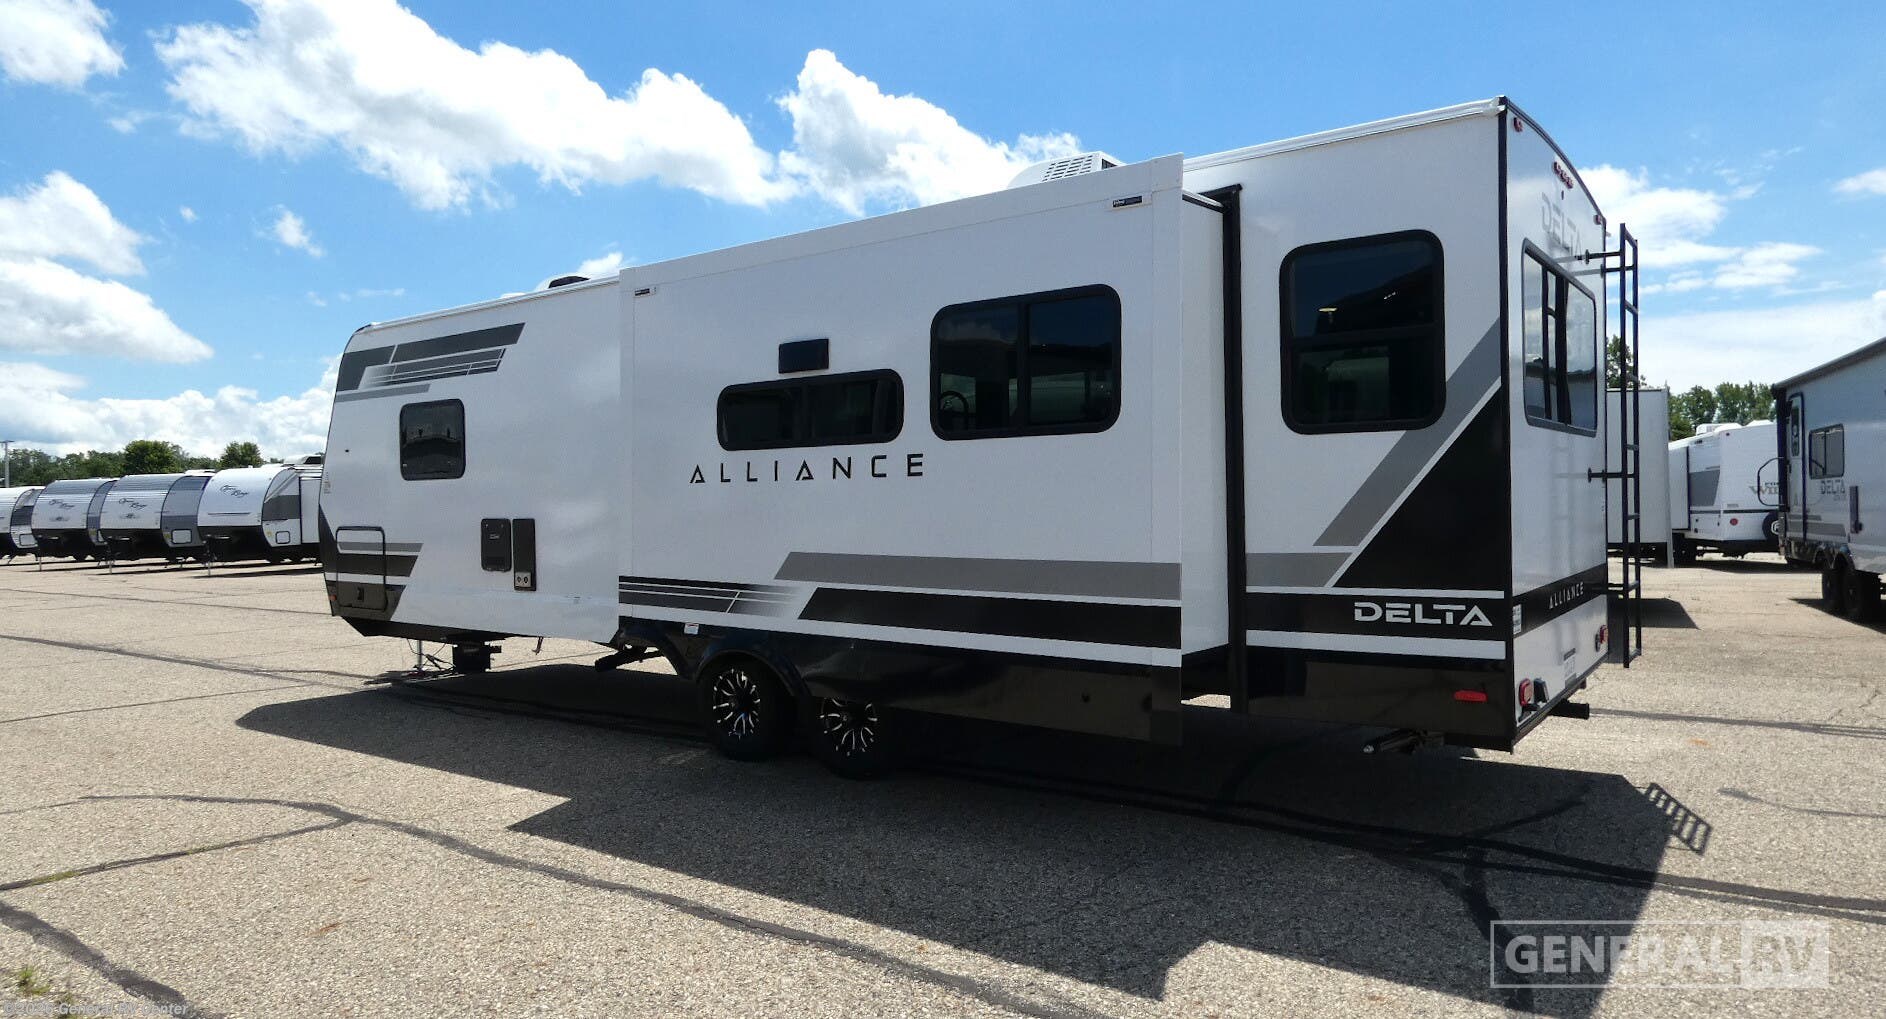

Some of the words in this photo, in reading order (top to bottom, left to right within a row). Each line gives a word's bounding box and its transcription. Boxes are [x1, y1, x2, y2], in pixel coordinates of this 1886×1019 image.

[1541, 191, 1583, 263] DELTA
[690, 453, 924, 484] ALLIANCE
[1820, 479, 1846, 494] DELTA
[1548, 581, 1584, 609] ALLIANCE
[1354, 601, 1493, 627] DELTA
